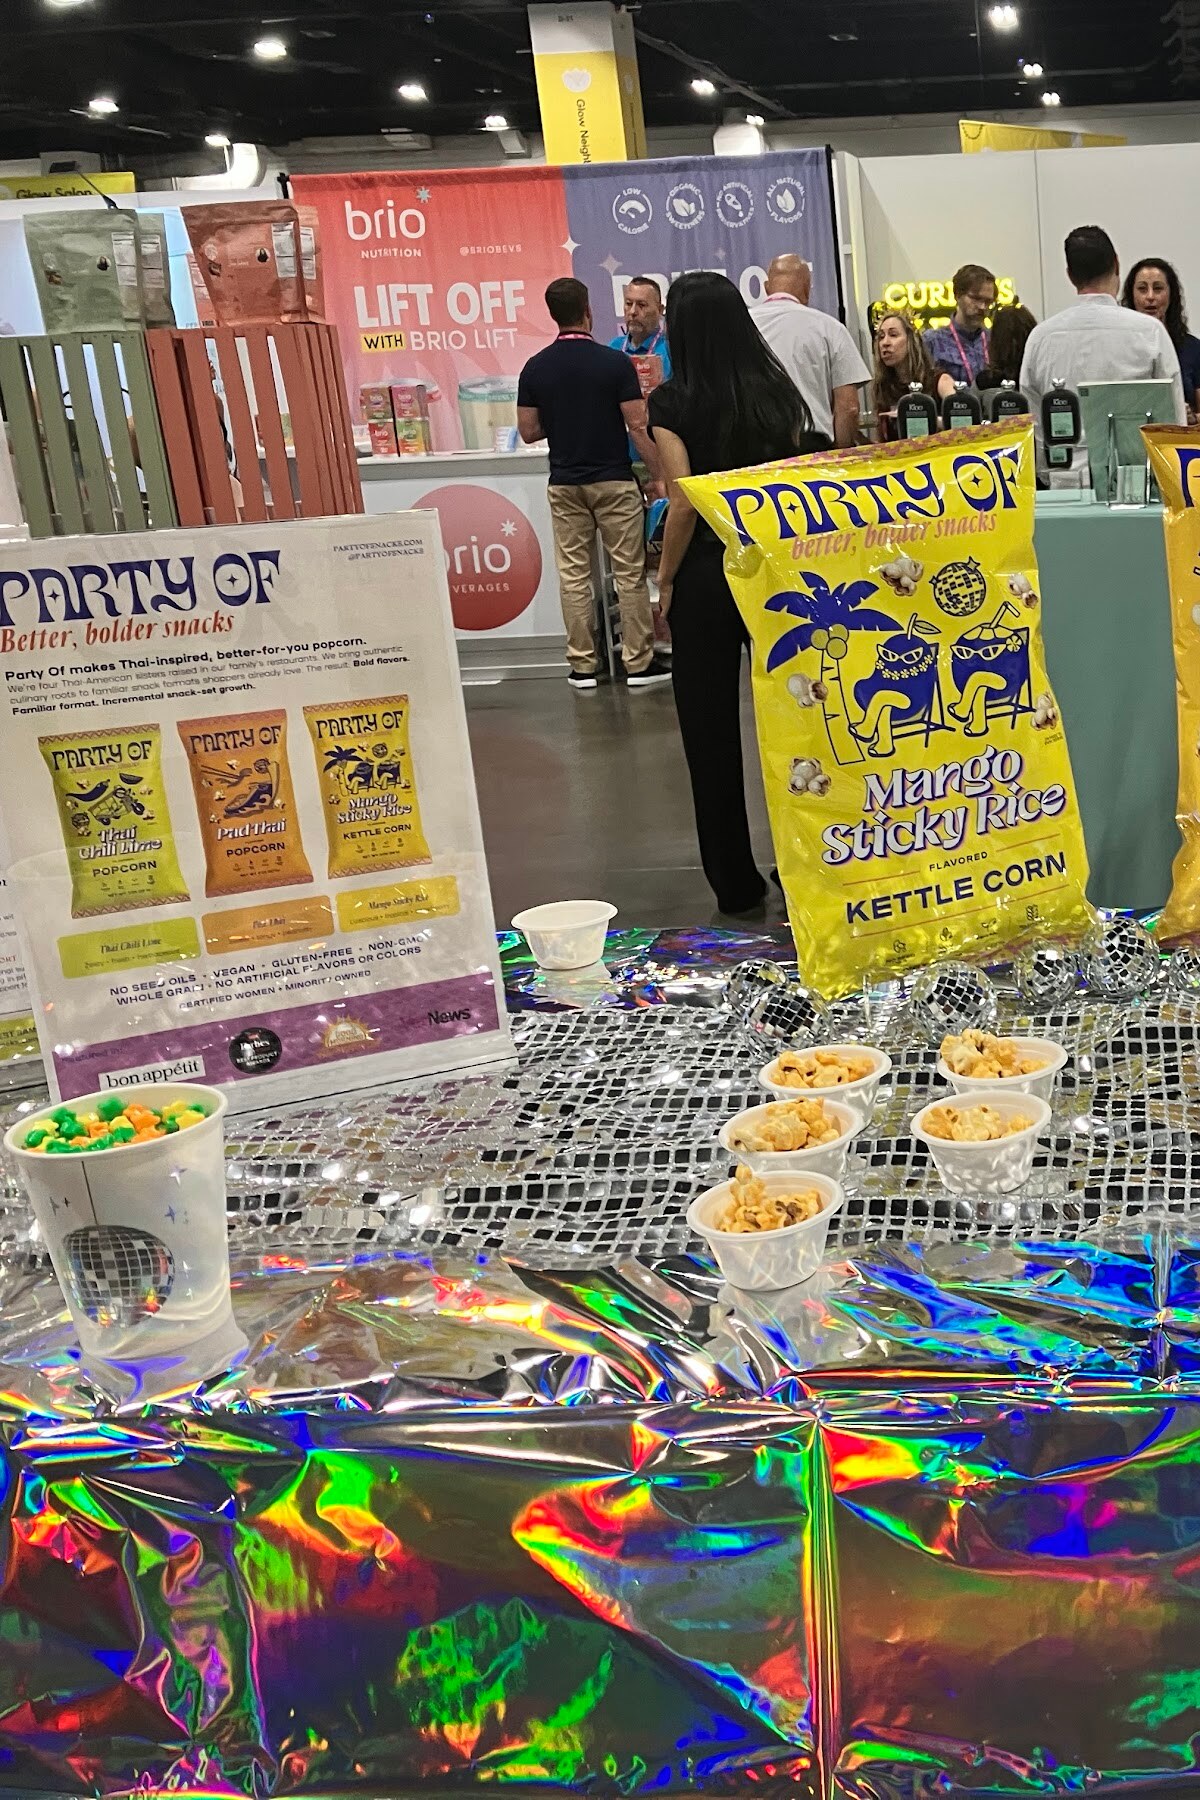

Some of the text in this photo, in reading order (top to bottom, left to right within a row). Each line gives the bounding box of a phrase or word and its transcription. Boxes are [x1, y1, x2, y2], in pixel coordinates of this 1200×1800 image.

[577, 99, 592, 163] Glow Neigh
[16, 187, 93, 198] Glow Salon
[622, 188, 642, 197] LOW
[669, 182, 702, 197] ORGANIC
[766, 177, 806, 197] ALL NATURAL
[345, 200, 426, 241] brio
[618, 223, 650, 235] CALORIE
[665, 210, 706, 230] SWEETENERS
[770, 212, 803, 224] FLAVORS
[361, 248, 422, 259] NUTRITION
[459, 244, 522, 257] @BRIOBEVS
[354, 280, 526, 328] LIFT OFF
[364, 328, 518, 351] WITH BRIO LIFT
[719, 449, 1021, 546] PARTY OF
[792, 508, 997, 560] better, bolder snacks
[444, 536, 512, 574] rio
[0, 550, 281, 627] PARTY OF
[452, 583, 510, 594] VERAGES
[1, 610, 235, 653] Better, bolder snacks
[5, 637, 367, 682] Party Of makes Thai-inspired, better-for-you popcorn.
[7, 684, 36, 693] We're
[38, 681, 58, 691] four
[61, 673, 133, 687] Thai-American
[136, 671, 166, 681] sisters
[168, 667, 198, 677] raised
[200, 665, 209, 673] in
[210, 664, 226, 673] our
[229, 661, 264, 671] family's
[322, 652, 336, 661] We
[338, 650, 361, 660] bring
[363, 645, 403, 657] authentic
[10, 694, 48, 705] culinary
[51, 690, 77, 700] roots
[79, 689, 90, 697] to
[92, 685, 129, 696] familiar
[131, 682, 161, 692] snack
[162, 678, 201, 689] formats
[247, 669, 281, 680] already
[306, 664, 323, 673] The
[353, 658, 375, 668] Bold
[376, 656, 410, 666] flavors.
[12, 683, 256, 716] Familiar format. Incremental snack-set growth.
[316, 711, 403, 738] PARTY OF
[189, 725, 282, 754] PARTY OF
[51, 744, 122, 770] PARTY
[128, 740, 152, 761] OF
[863, 744, 1024, 813] Mango
[336, 803, 412, 825] Sticky Rice
[349, 793, 398, 811] Mango
[98, 825, 138, 843] Thai
[217, 818, 287, 842] Pad Thai
[343, 824, 412, 840] KETTLE CORN
[821, 782, 1067, 867] Sticky Rice
[79, 839, 162, 860] Chili Lime
[226, 842, 285, 858] POPCORN
[929, 852, 988, 872] FLAVORED
[93, 861, 157, 877] POPCORN
[846, 852, 1067, 924] KETTLE CORN
[110, 935, 424, 996] NO SEED OILS VEGAN GLUTEN-FREE NON-GMO
[116, 946, 422, 1006] WHOLE GRAIN NO ARTIFICIAL FLAVORS OR COLORS
[179, 994, 232, 1009] CERTIFIED
[235, 987, 276, 1000] WOMEN
[335, 970, 371, 982] OWNED
[427, 1008, 471, 1026] News
[106, 1061, 200, 1088] bon appétit
